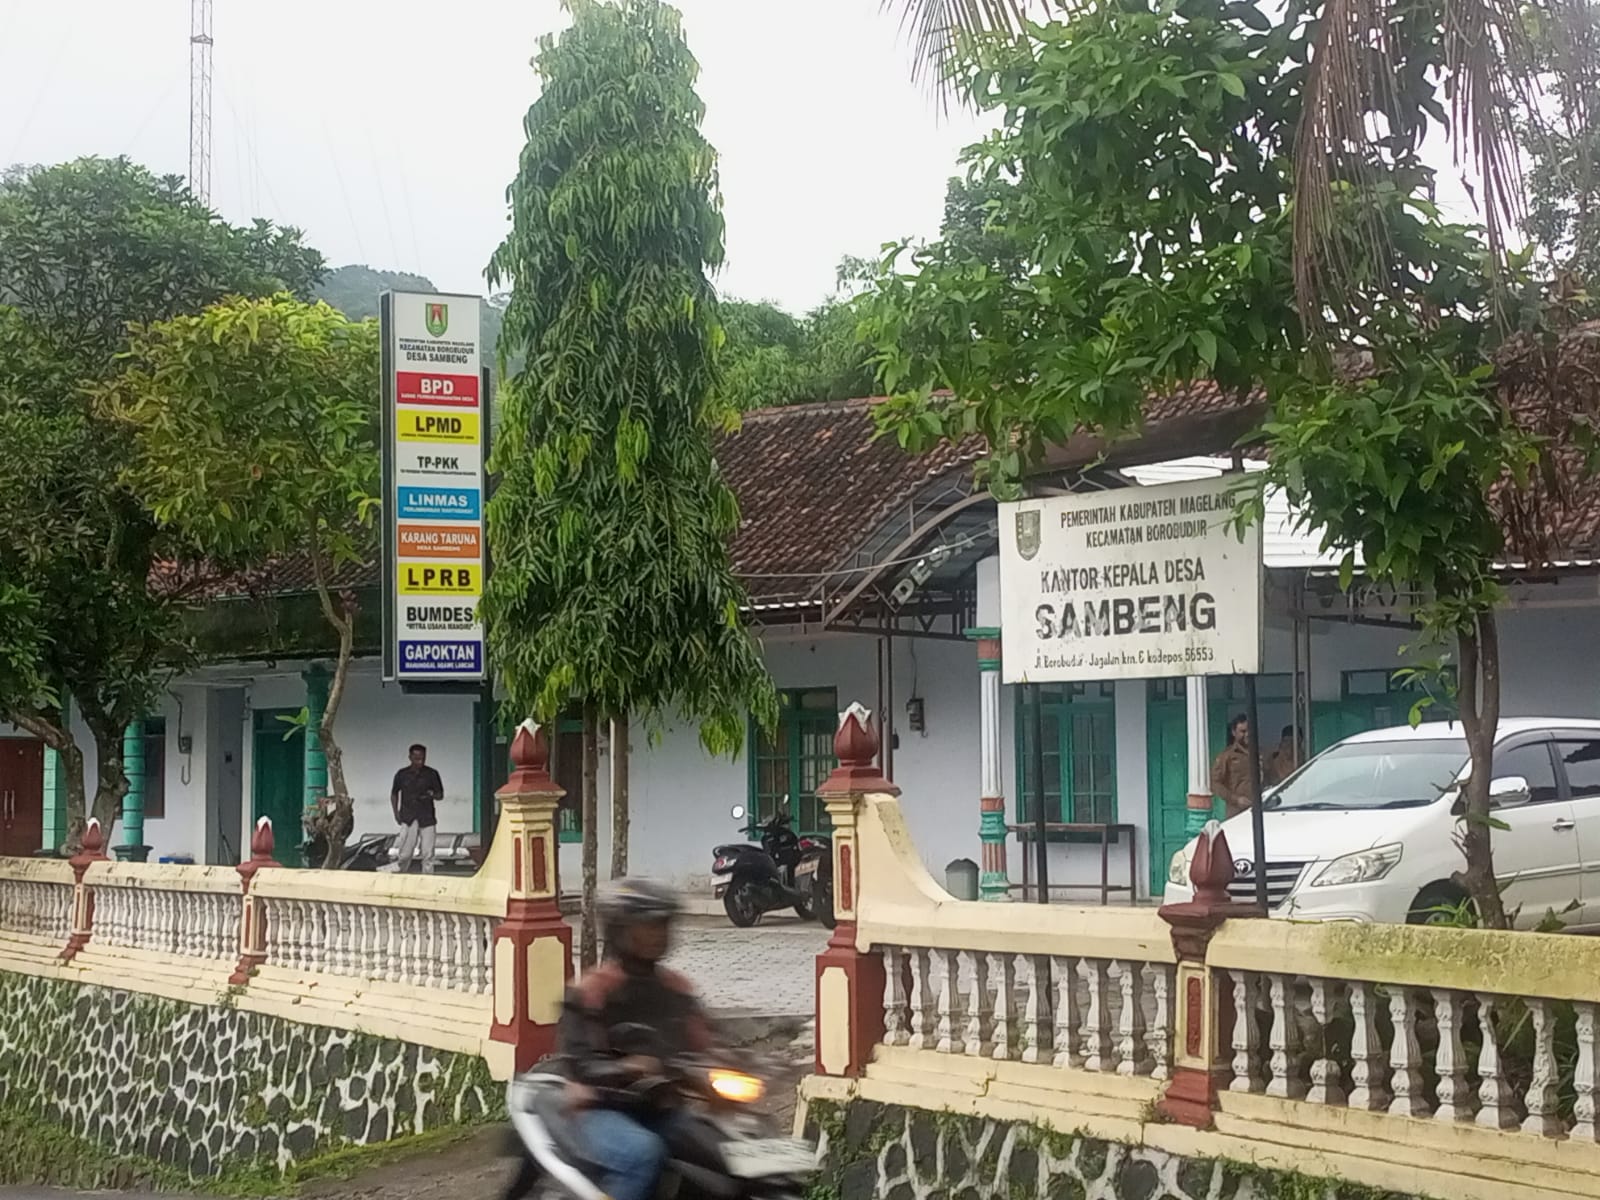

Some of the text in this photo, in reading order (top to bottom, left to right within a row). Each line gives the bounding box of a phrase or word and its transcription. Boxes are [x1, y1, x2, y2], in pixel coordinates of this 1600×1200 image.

[400, 344, 474, 354] KECAMATAN BOROBUDUR
[406, 352, 468, 364] DESA SAMBENG
[420, 378, 454, 395] BPD
[415, 416, 462, 433] LPMD
[417, 456, 459, 470] TP-PKK
[409, 493, 468, 507] LINMAS
[1060, 492, 1236, 528] PEMERINTAH KABUPATEN MAGELANG
[401, 532, 477, 545] KARANG TARUNA
[1086, 519, 1207, 548] KECAMATAN BOROBUDUR
[1040, 557, 1206, 594] KANTOR KEPALA DESA
[406, 606, 473, 622] BUMDES
[1035, 592, 1217, 640] SAMBENG
[405, 644, 475, 660] GAPOKTAN
[1147, 648, 1183, 665] kodepos
[1184, 647, 1215, 662] 56553
